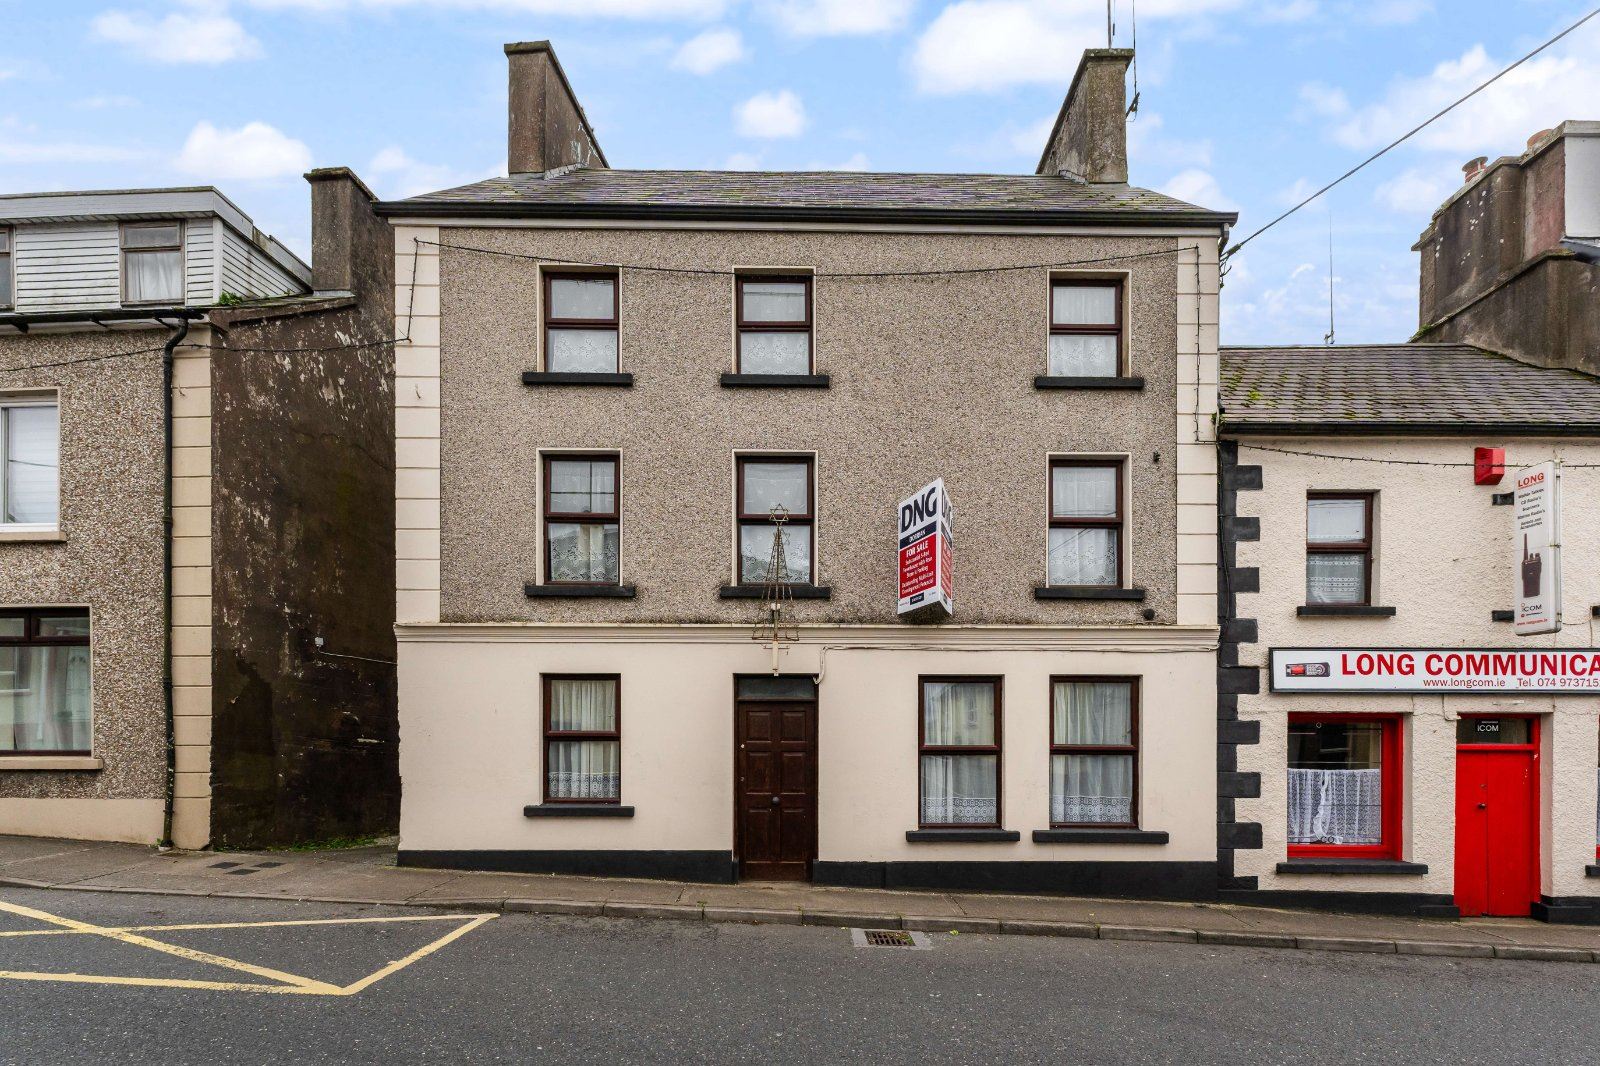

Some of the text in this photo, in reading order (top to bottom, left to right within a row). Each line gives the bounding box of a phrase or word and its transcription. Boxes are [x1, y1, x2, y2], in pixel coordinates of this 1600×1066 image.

[1518, 472, 1544, 488] LONG
[901, 486, 938, 534] DNG
[907, 540, 929, 558] FOR SALE
[1341, 653, 1600, 676] LONG COMMUNICA
[1423, 678, 1600, 689] www.longcom.ie Tel. 074 973715
